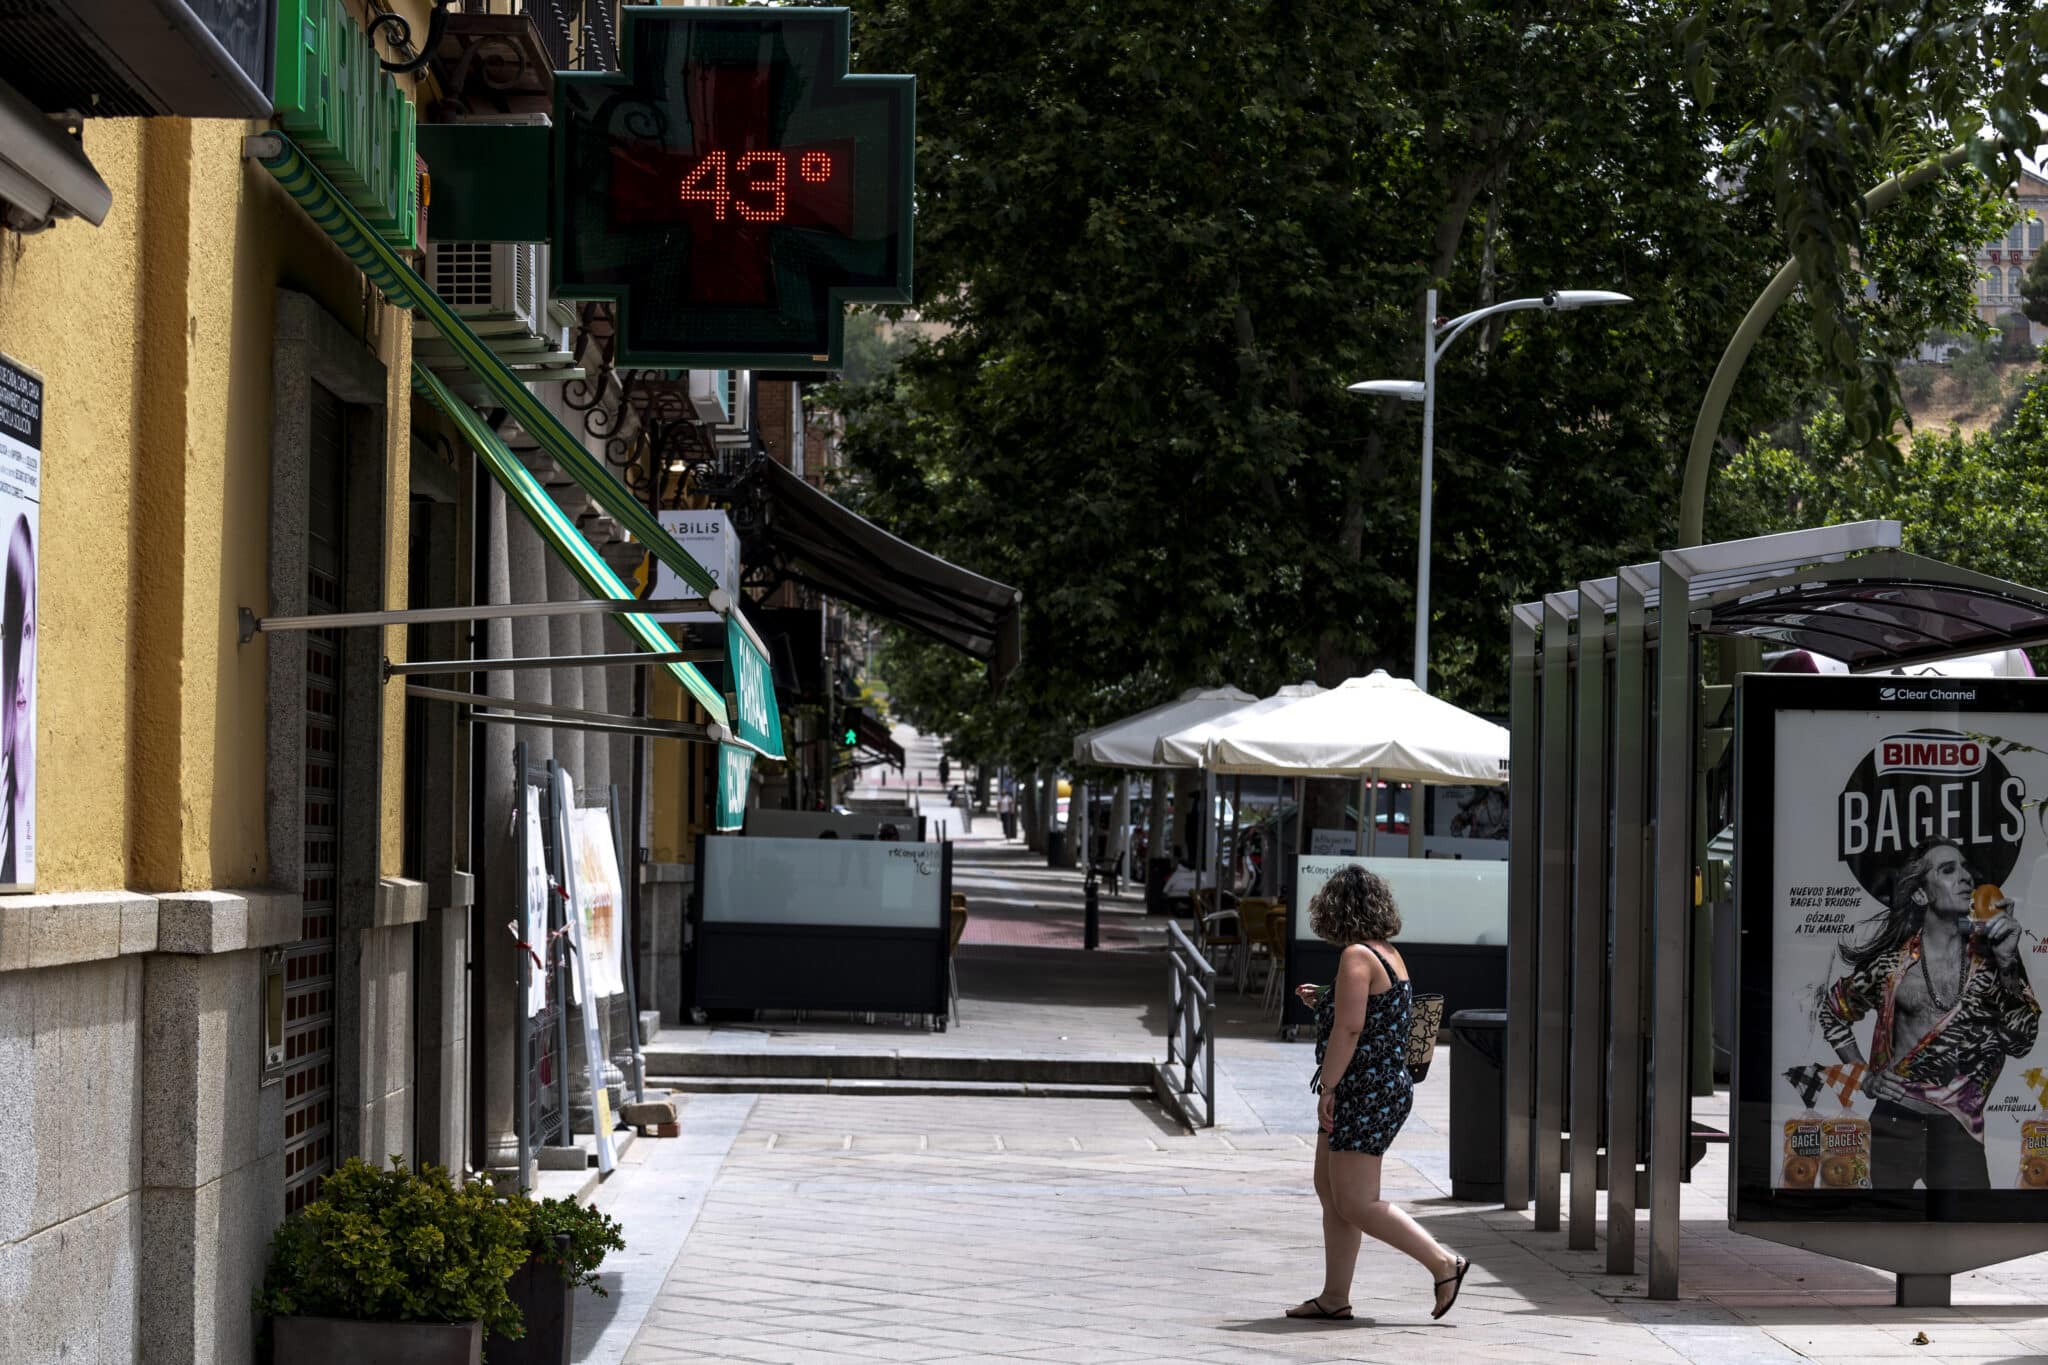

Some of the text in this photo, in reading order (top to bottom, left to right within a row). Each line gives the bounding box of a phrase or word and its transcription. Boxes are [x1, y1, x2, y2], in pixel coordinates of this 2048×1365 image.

[275, 0, 418, 250] FARMACIA
[1897, 688, 1976, 700] Clear Channel
[1883, 744, 1980, 765] BIMBO
[1844, 776, 2025, 855] BAGELS
[1790, 887, 1824, 896] NUEVOS
[1790, 898, 1862, 907] BAGELS BRIOCHE
[1806, 912, 1846, 922] GÓZALOS
[1804, 924, 1815, 934] TU
[1817, 924, 1854, 934] MANERA
[2004, 1096, 2019, 1104] CON
[1986, 1104, 2036, 1112] MANTEQUILLA
[1828, 1134, 1864, 1148] BAGELS
